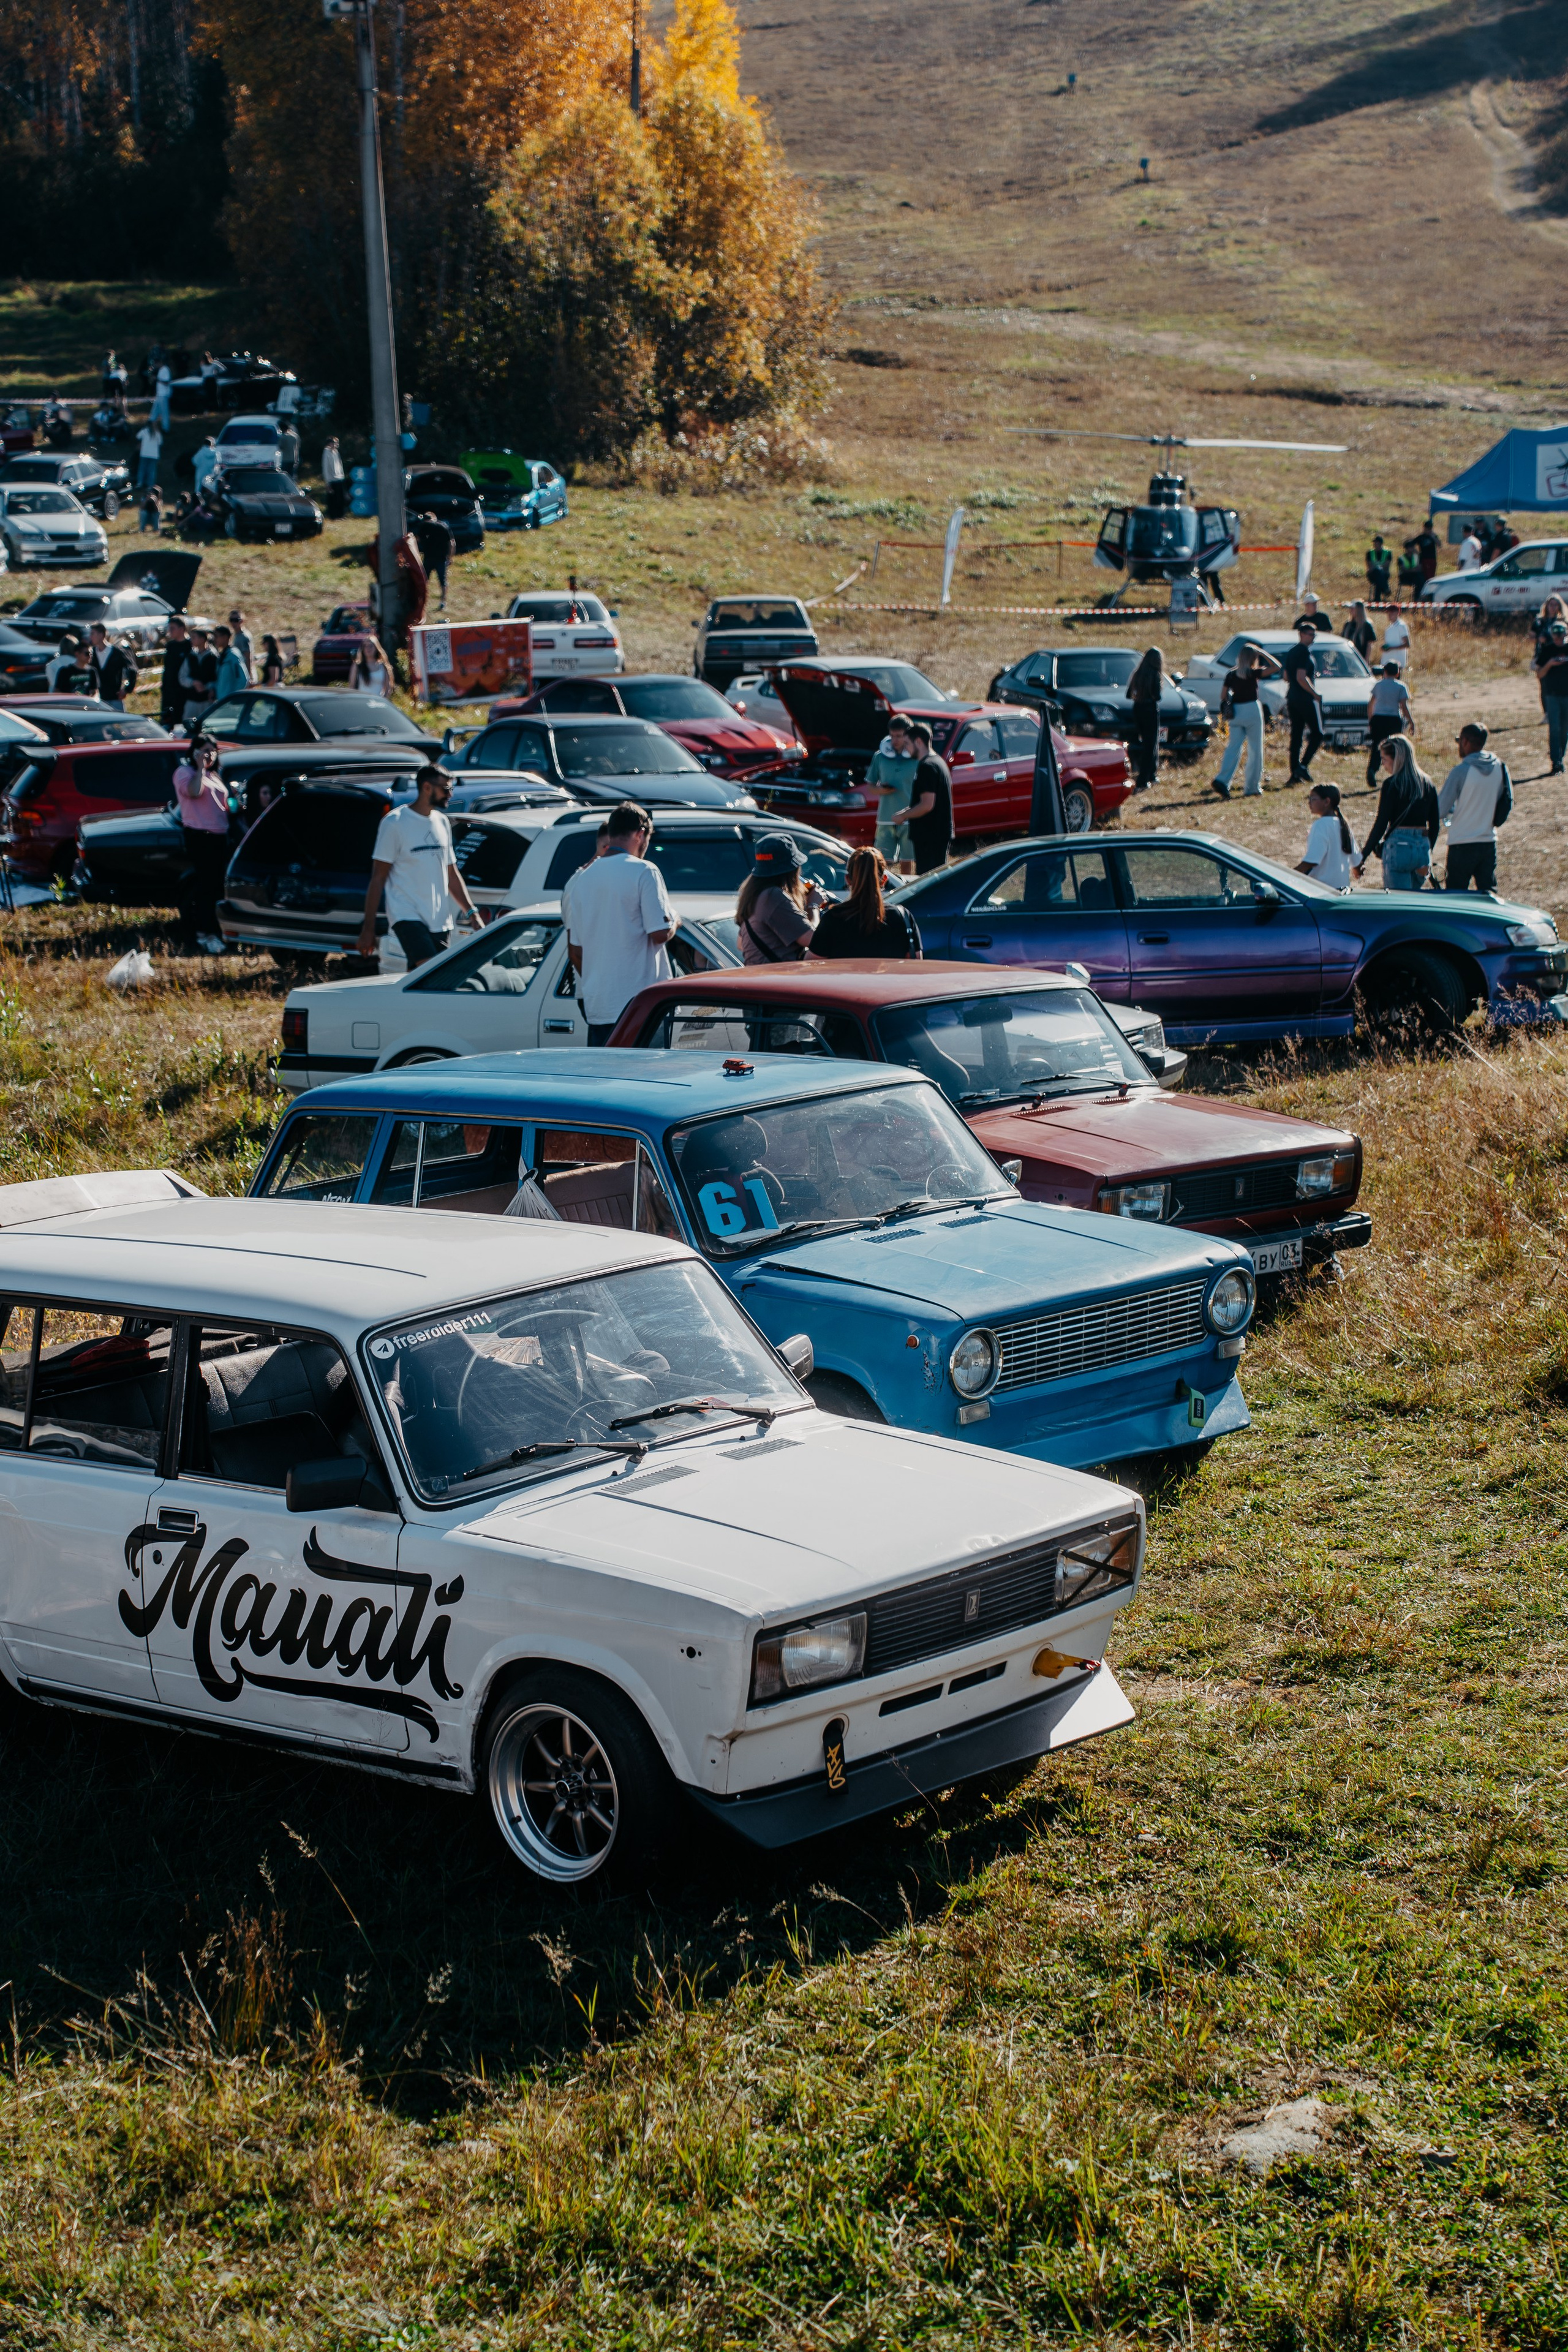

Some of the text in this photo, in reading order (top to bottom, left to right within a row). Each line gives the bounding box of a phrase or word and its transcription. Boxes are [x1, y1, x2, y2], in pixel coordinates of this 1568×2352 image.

[698, 1179, 780, 1237] 61
[1282, 1243, 1297, 1260] 03
[393, 1311, 492, 1350] freeraider111
